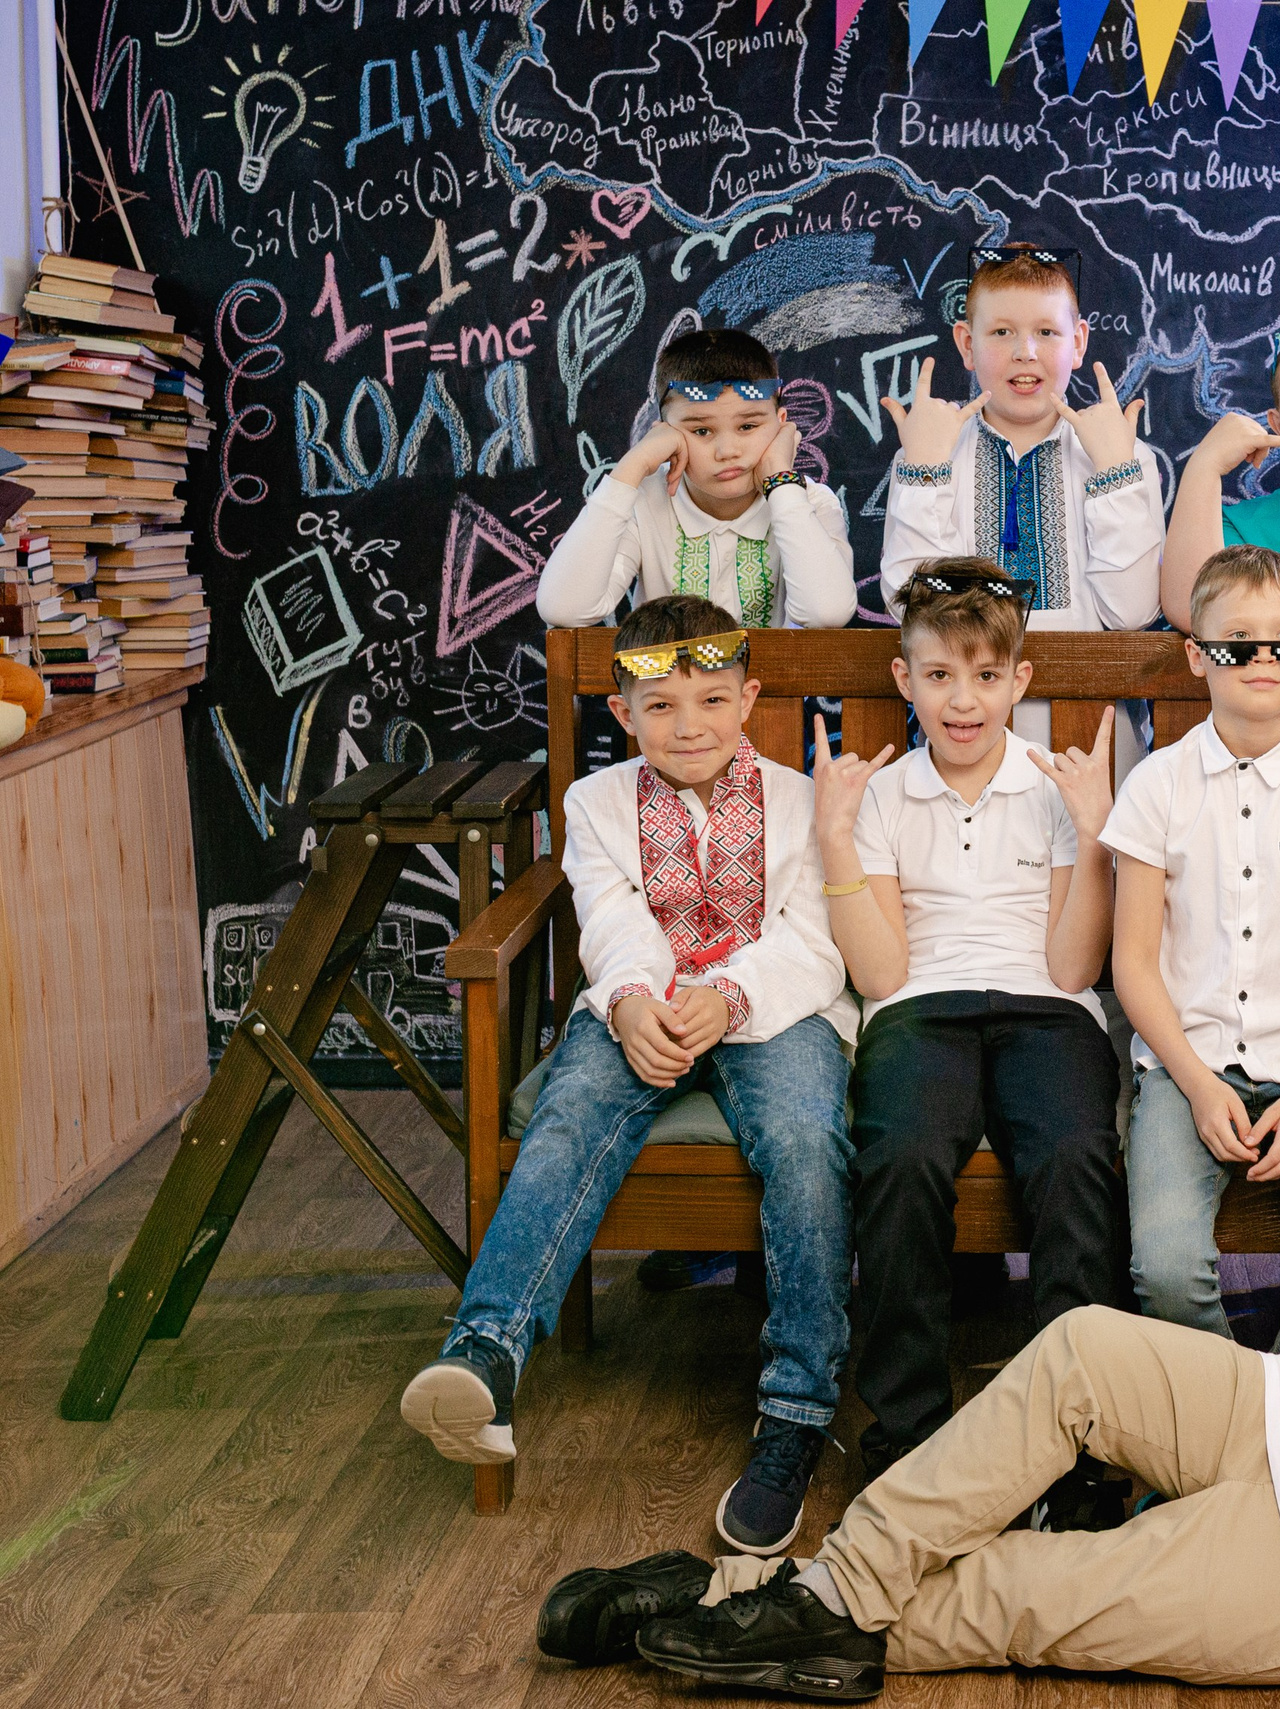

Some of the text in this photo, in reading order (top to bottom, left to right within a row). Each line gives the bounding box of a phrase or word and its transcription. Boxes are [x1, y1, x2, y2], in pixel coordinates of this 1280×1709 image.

[345, 20, 497, 169] ДНК
[1070, 87, 1207, 149] Черкаси
[500, 101, 601, 169] Ужгород
[900, 101, 1039, 152] Вінниця
[1151, 252, 1273, 297] Миколаїв
[1080, 309, 1132, 335] еса
